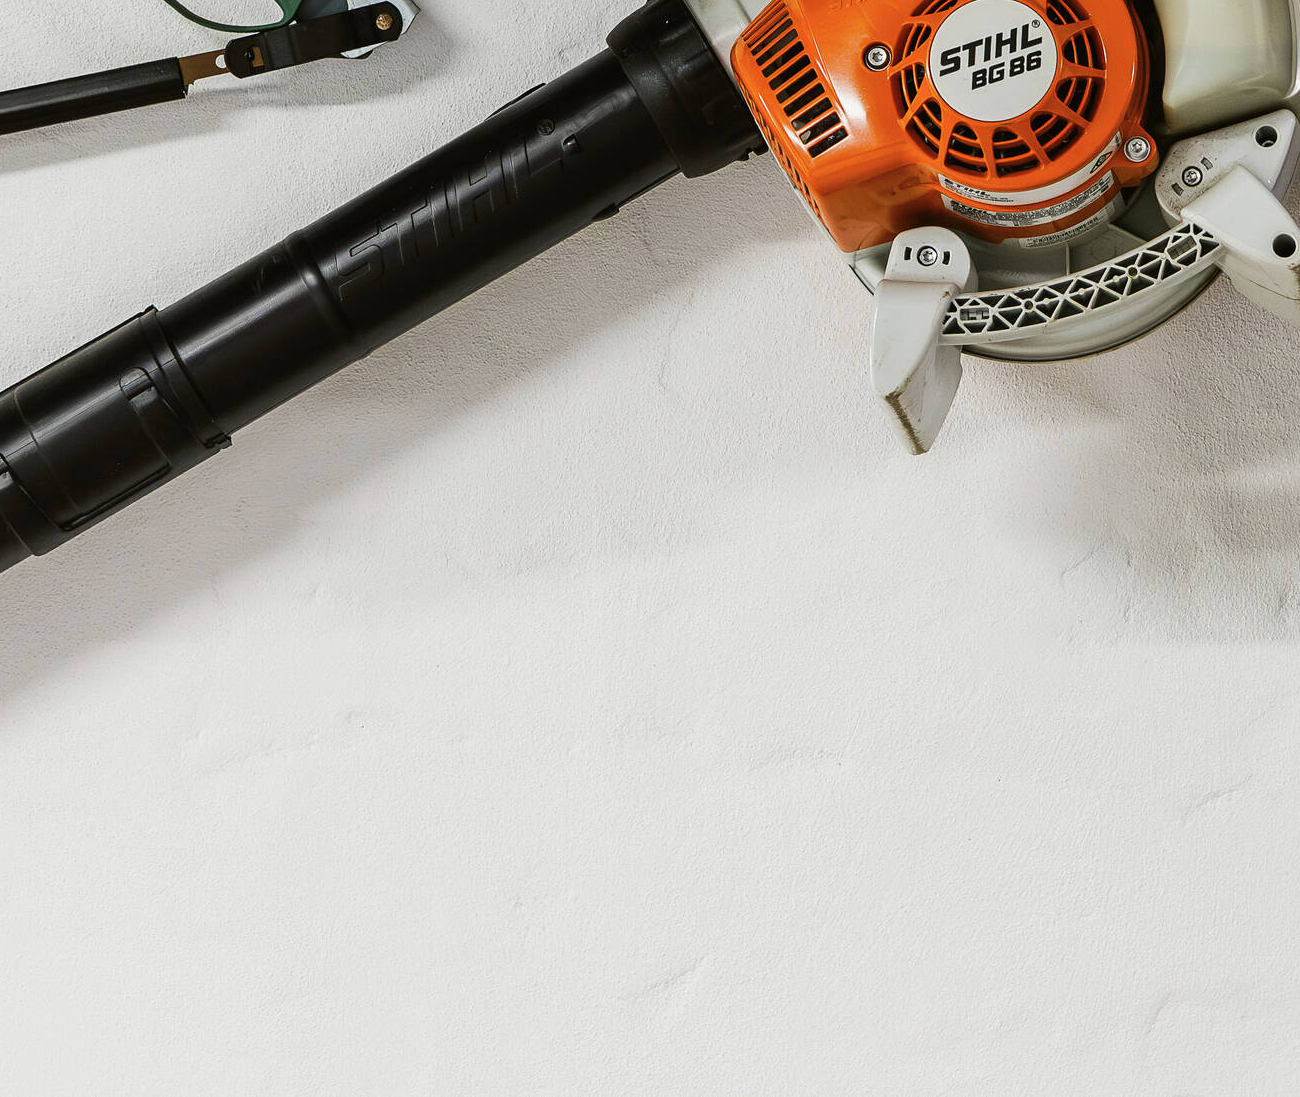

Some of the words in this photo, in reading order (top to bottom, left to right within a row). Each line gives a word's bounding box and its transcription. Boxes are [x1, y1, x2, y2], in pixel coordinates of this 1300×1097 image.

[939, 22, 1043, 77] STIHL
[971, 61, 1005, 90] BG
[1009, 50, 1042, 78] 86
[336, 133, 566, 301] STIHL
